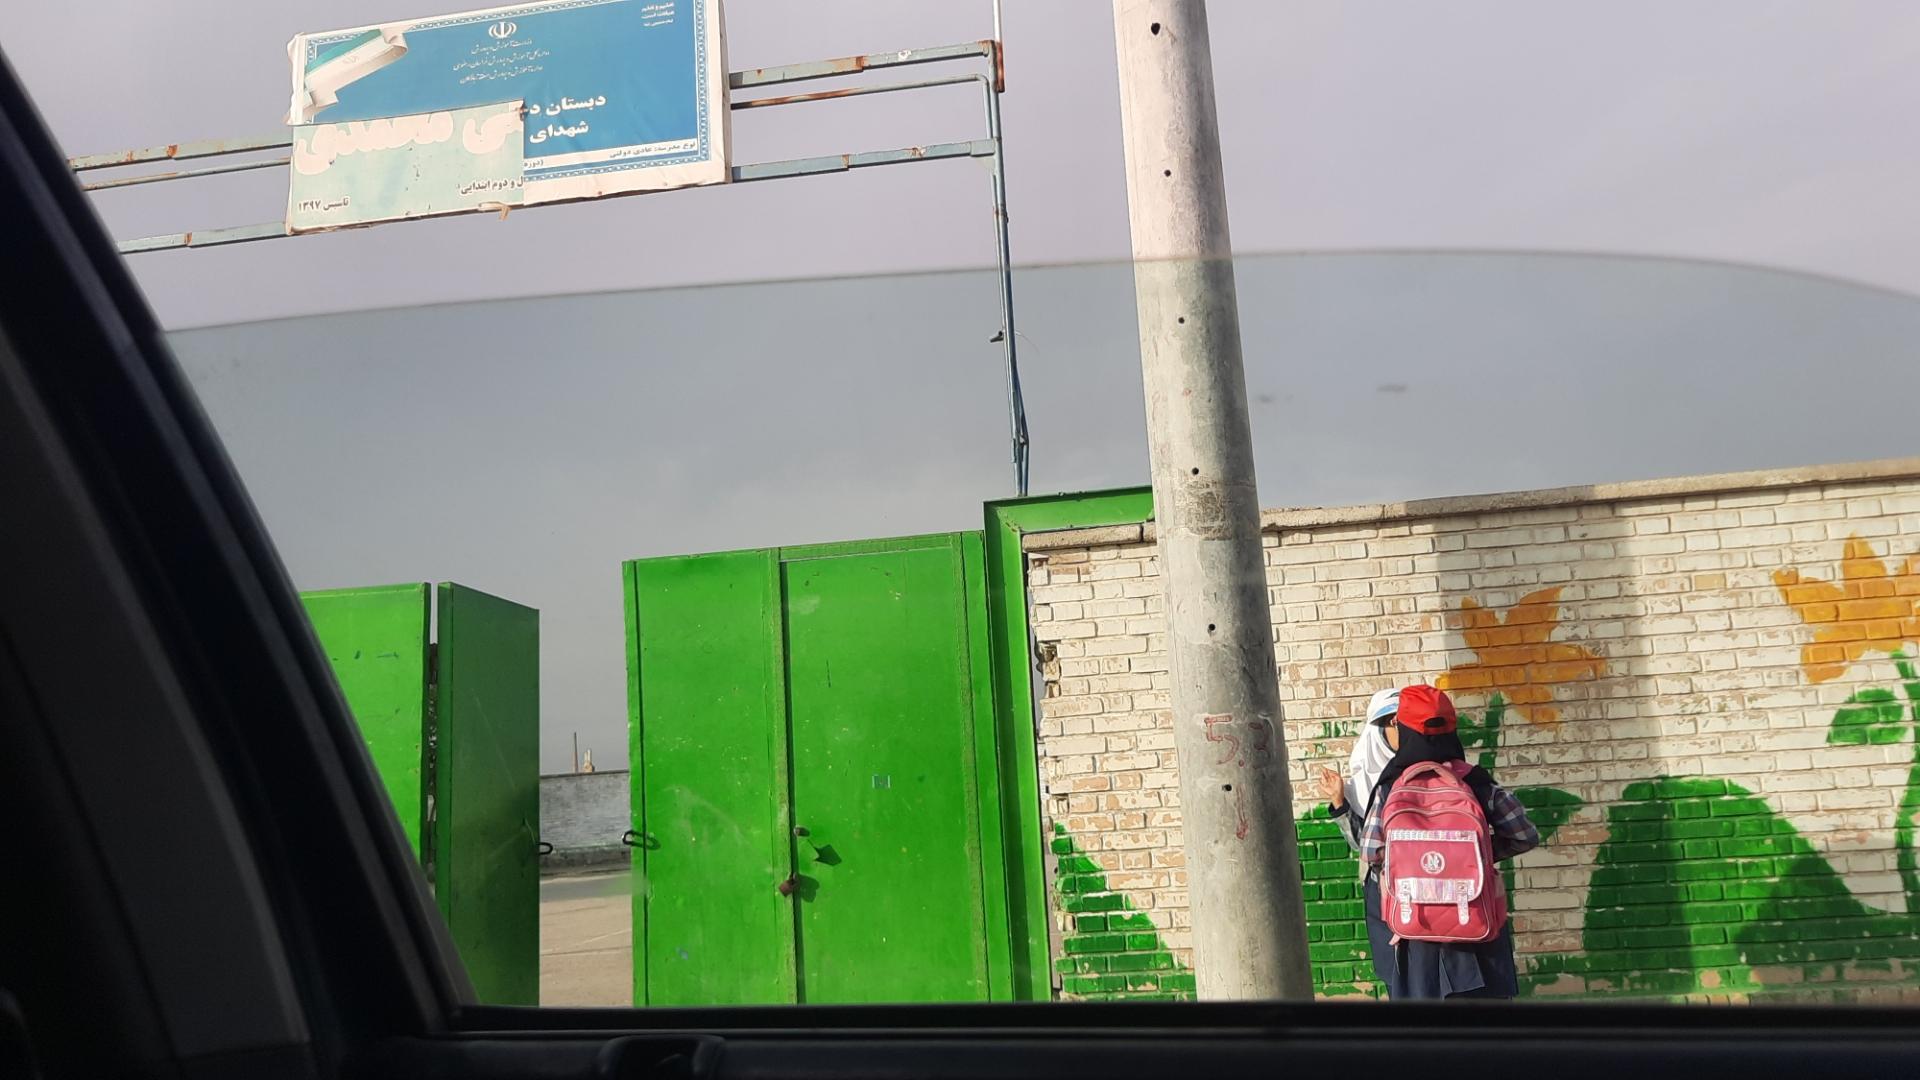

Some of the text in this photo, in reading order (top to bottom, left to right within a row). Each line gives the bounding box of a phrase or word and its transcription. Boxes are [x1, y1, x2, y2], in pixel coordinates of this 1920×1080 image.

[546, 95, 606, 115] دبستان
[529, 120, 589, 144] شهدای
[633, 146, 652, 155] عادی
[683, 141, 696, 150] نوع
[609, 150, 632, 158] دولتی
[492, 179, 508, 190] دوم
[299, 200, 321, 211] ۱۳۹۷
